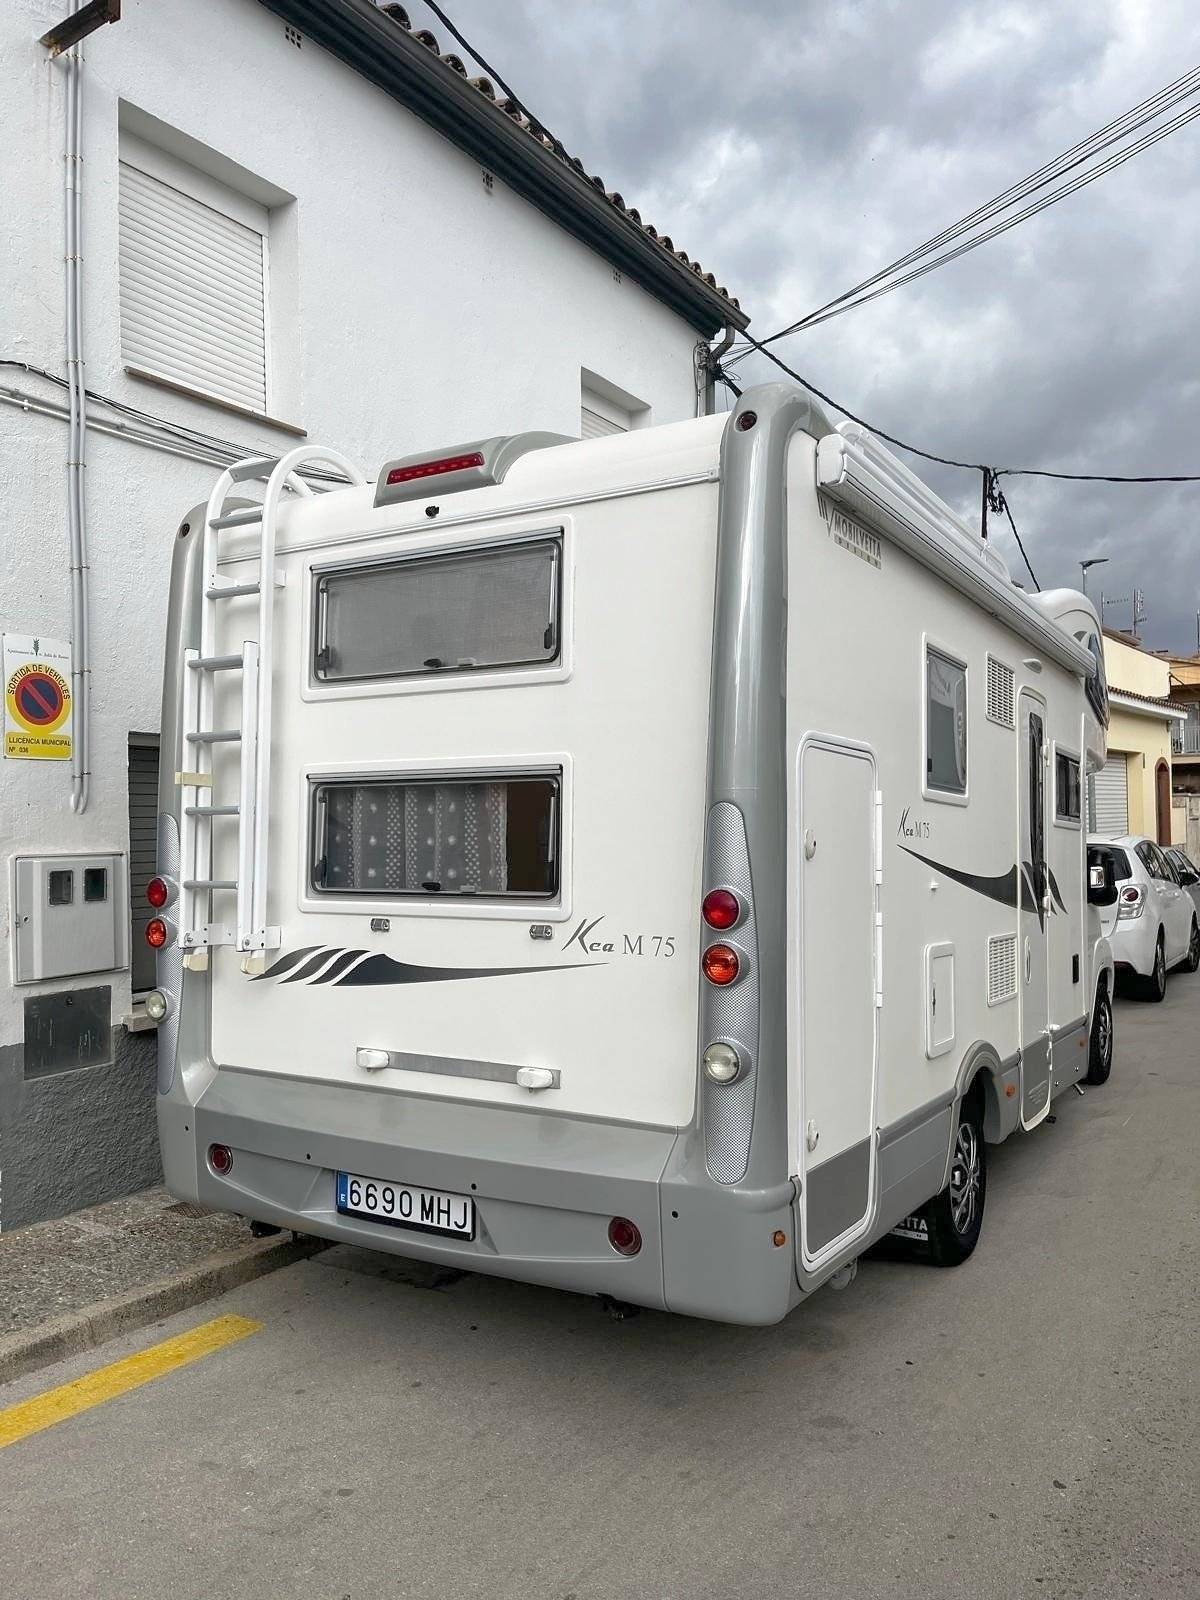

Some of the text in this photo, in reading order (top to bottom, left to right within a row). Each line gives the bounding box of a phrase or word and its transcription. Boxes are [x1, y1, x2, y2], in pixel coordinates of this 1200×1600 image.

[833, 511, 881, 560] MOBILVETTA
[8, 664, 70, 700] SORTIDA DE VEHICLES
[41, 738, 71, 747] MUNICIPAL
[561, 914, 676, 958] Kea M 75
[340, 1193, 346, 1202] E
[349, 1179, 468, 1230] 6690 MHJ
